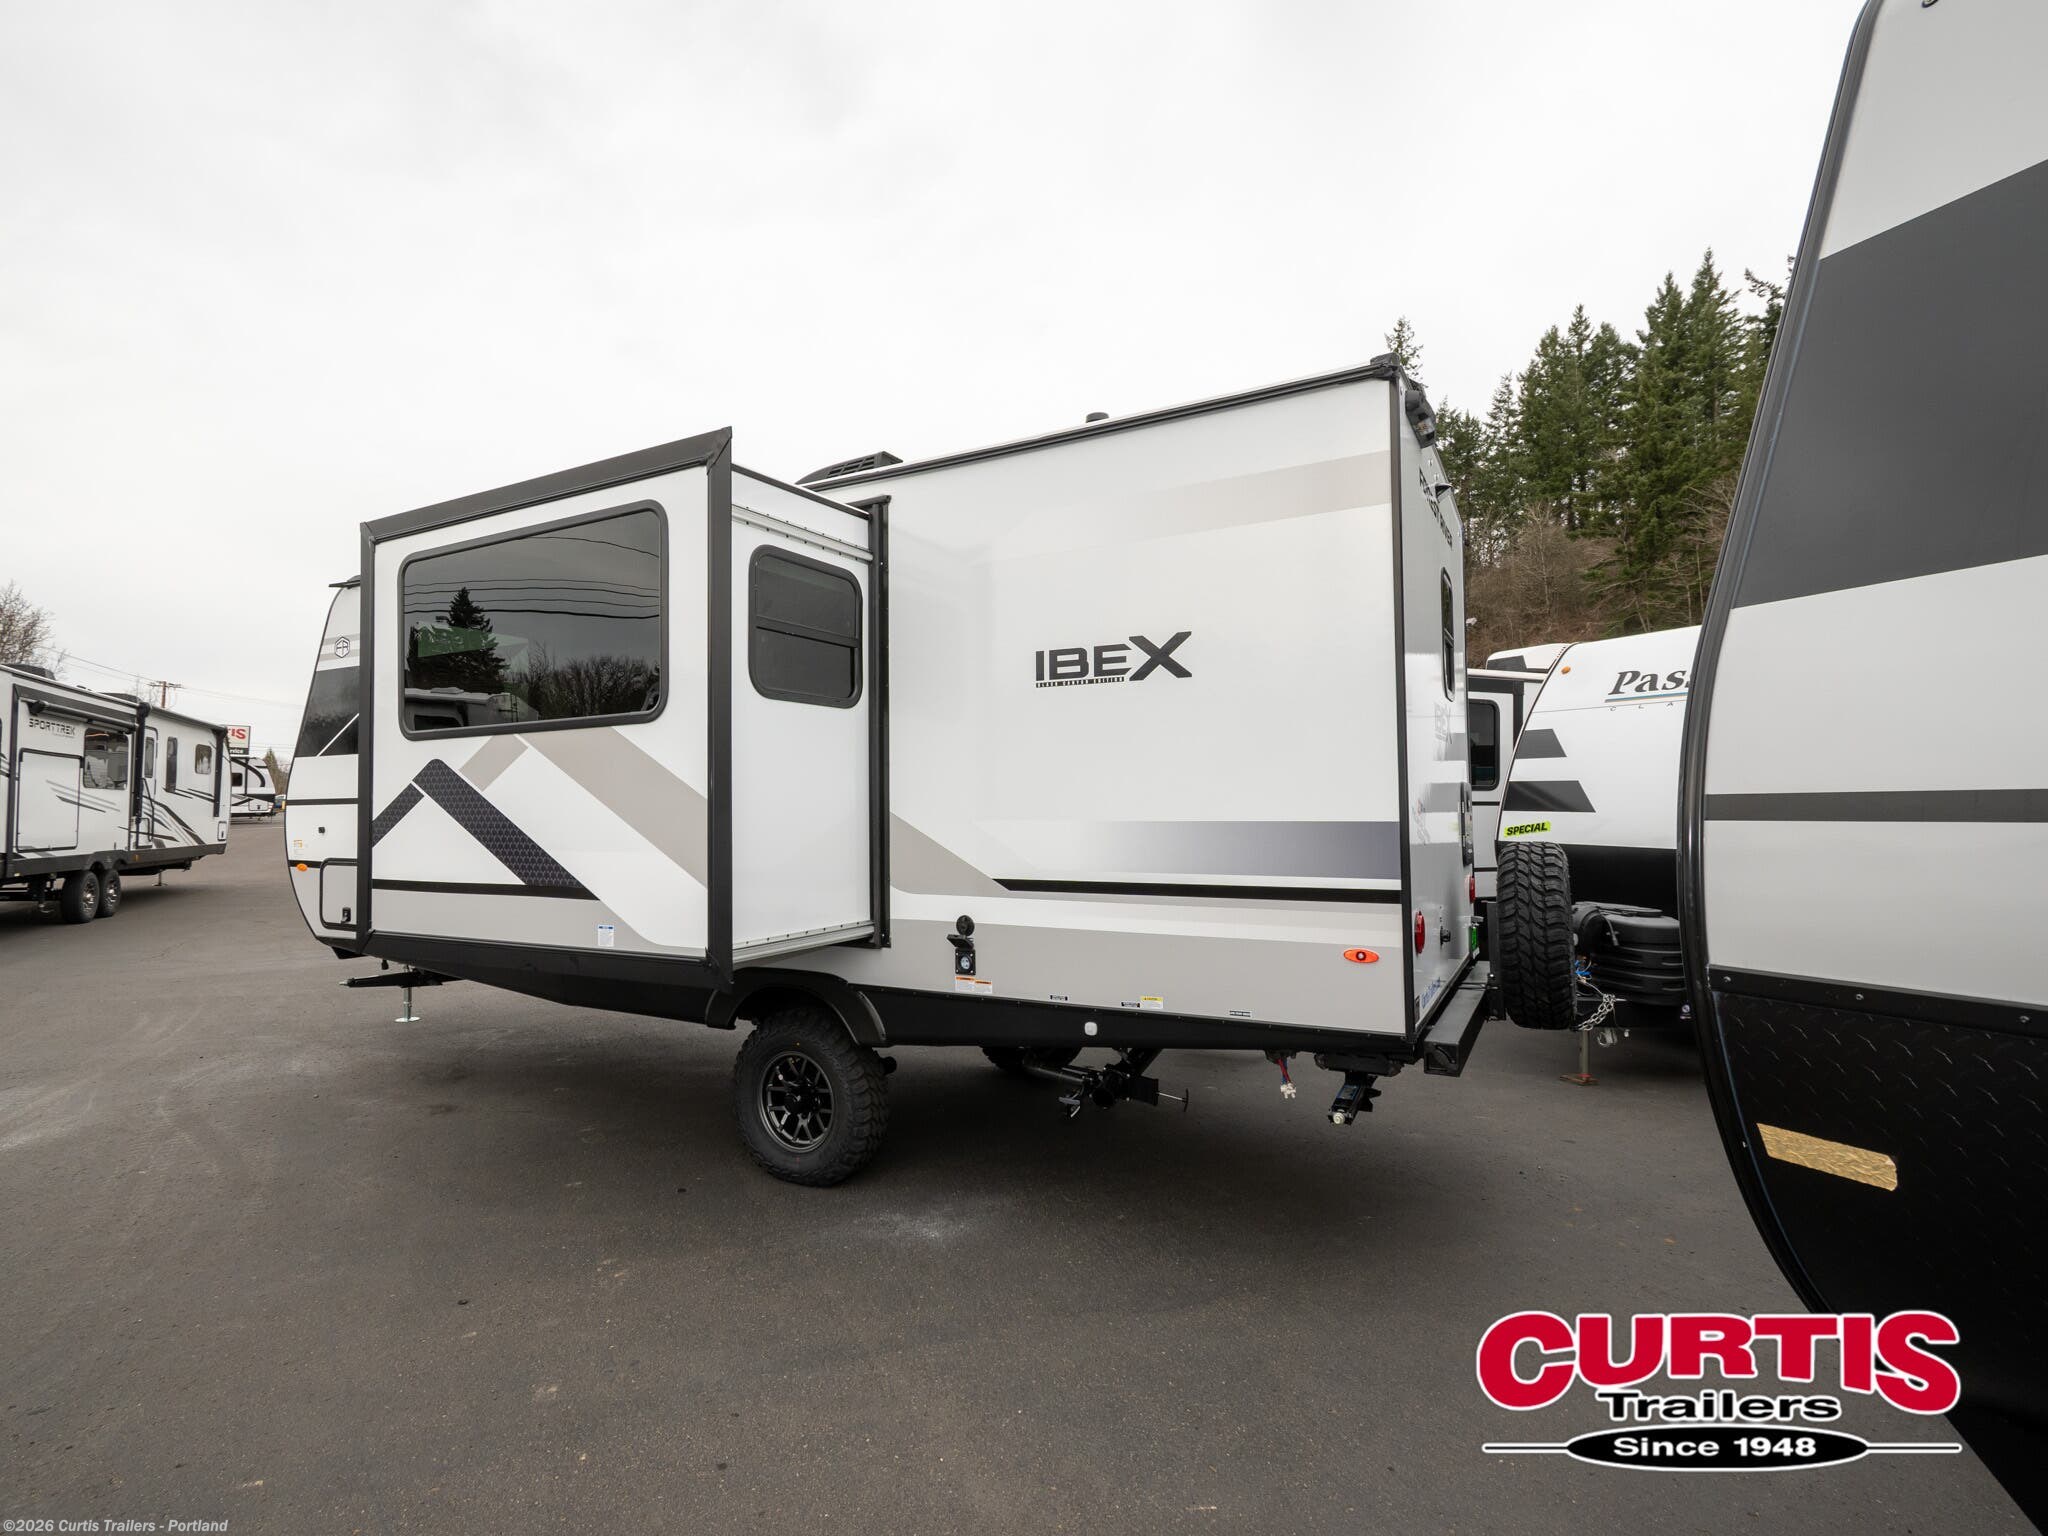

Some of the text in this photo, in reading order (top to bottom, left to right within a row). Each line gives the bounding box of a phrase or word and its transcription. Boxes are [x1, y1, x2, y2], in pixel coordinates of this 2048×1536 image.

[1035, 631, 1193, 682] IBEX
[1607, 670, 1690, 696] Pas
[29, 718, 75, 735] SPORTTREK
[228, 728, 246, 740] IS
[1506, 822, 1548, 836] SPECIAL
